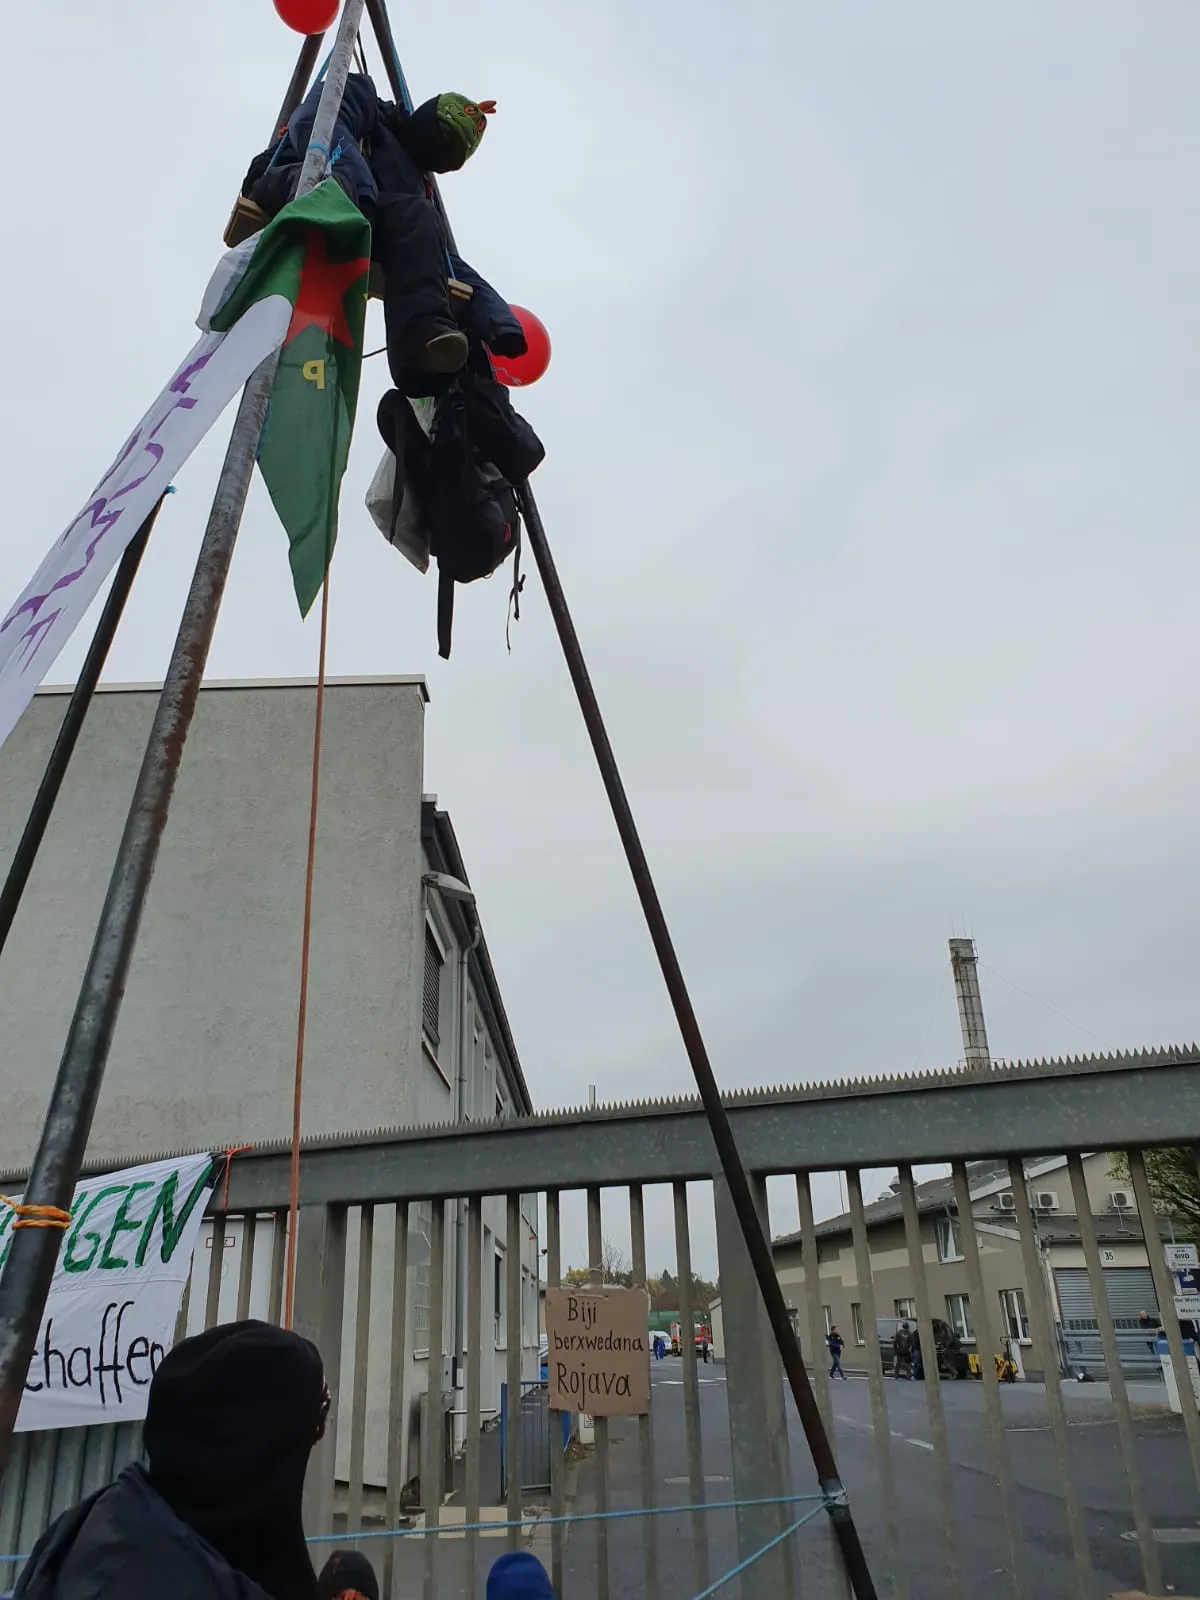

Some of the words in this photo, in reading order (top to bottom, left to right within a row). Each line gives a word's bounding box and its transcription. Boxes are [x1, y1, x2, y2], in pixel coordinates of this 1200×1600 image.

[1104, 1251, 1114, 1261] 35
[567, 1297, 597, 1330] Biji
[553, 1329, 644, 1352] berxwedana
[556, 1362, 632, 1411] Rojava
